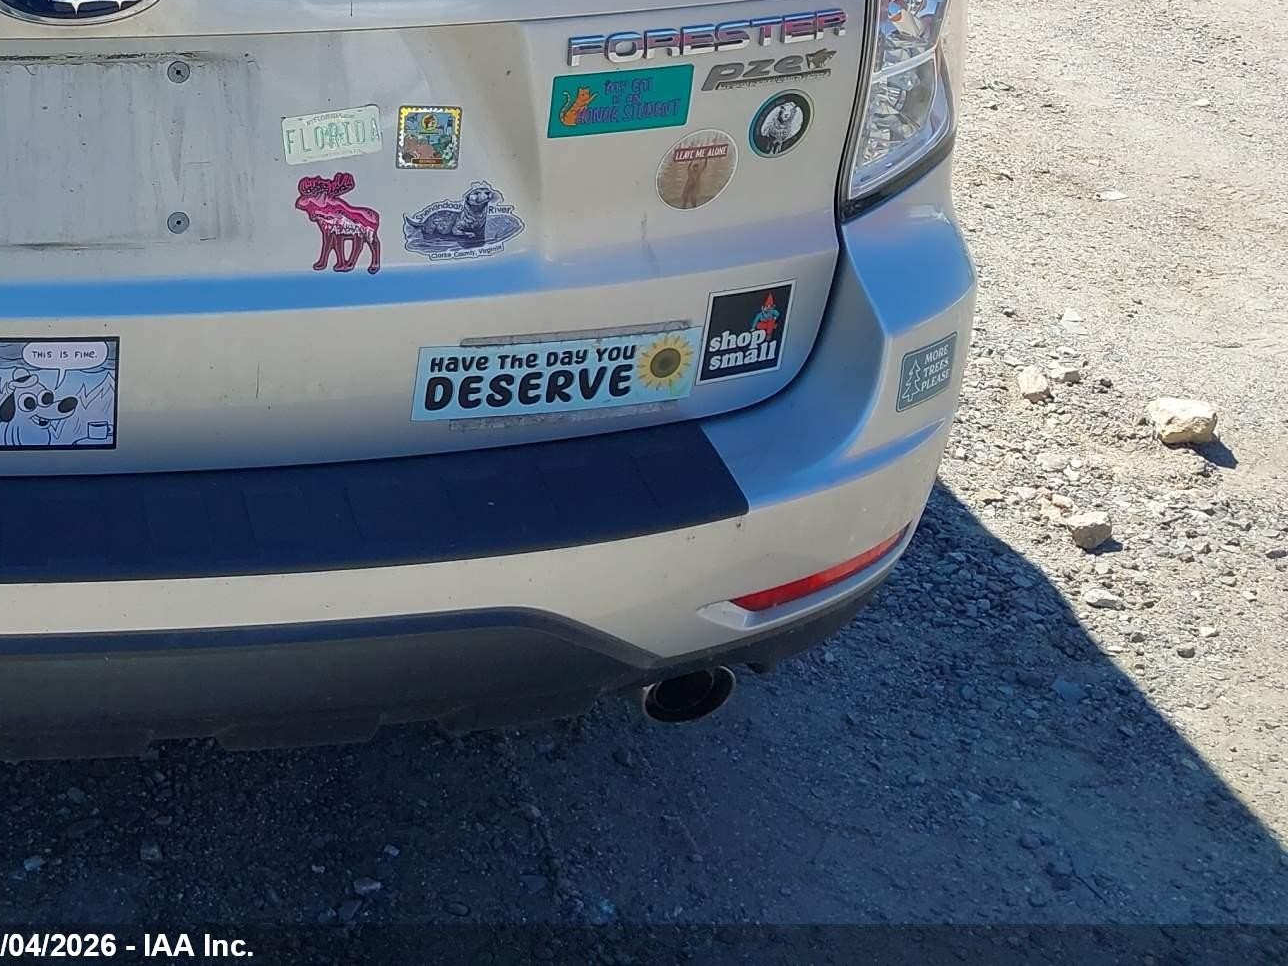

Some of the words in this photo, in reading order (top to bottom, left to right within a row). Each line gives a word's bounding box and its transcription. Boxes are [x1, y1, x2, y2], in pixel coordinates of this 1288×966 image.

[567, 8, 848, 67] FORESTER
[285, 117, 381, 155] FLORIDA
[675, 149, 694, 161] LEAVE
[695, 148, 706, 159] ME
[707, 146, 728, 158] ALONE
[415, 202, 464, 222] Shenandoah
[488, 205, 511, 214] River
[478, 245, 503, 255] Virginia
[708, 328, 768, 353] shop
[31, 350, 53, 359] THIS
[59, 350, 69, 359] IS
[708, 340, 777, 371] small
[924, 344, 949, 365] MORE
[922, 357, 949, 378] TREES
[423, 363, 634, 412] DESERVE
[920, 368, 950, 392] PLEASE
